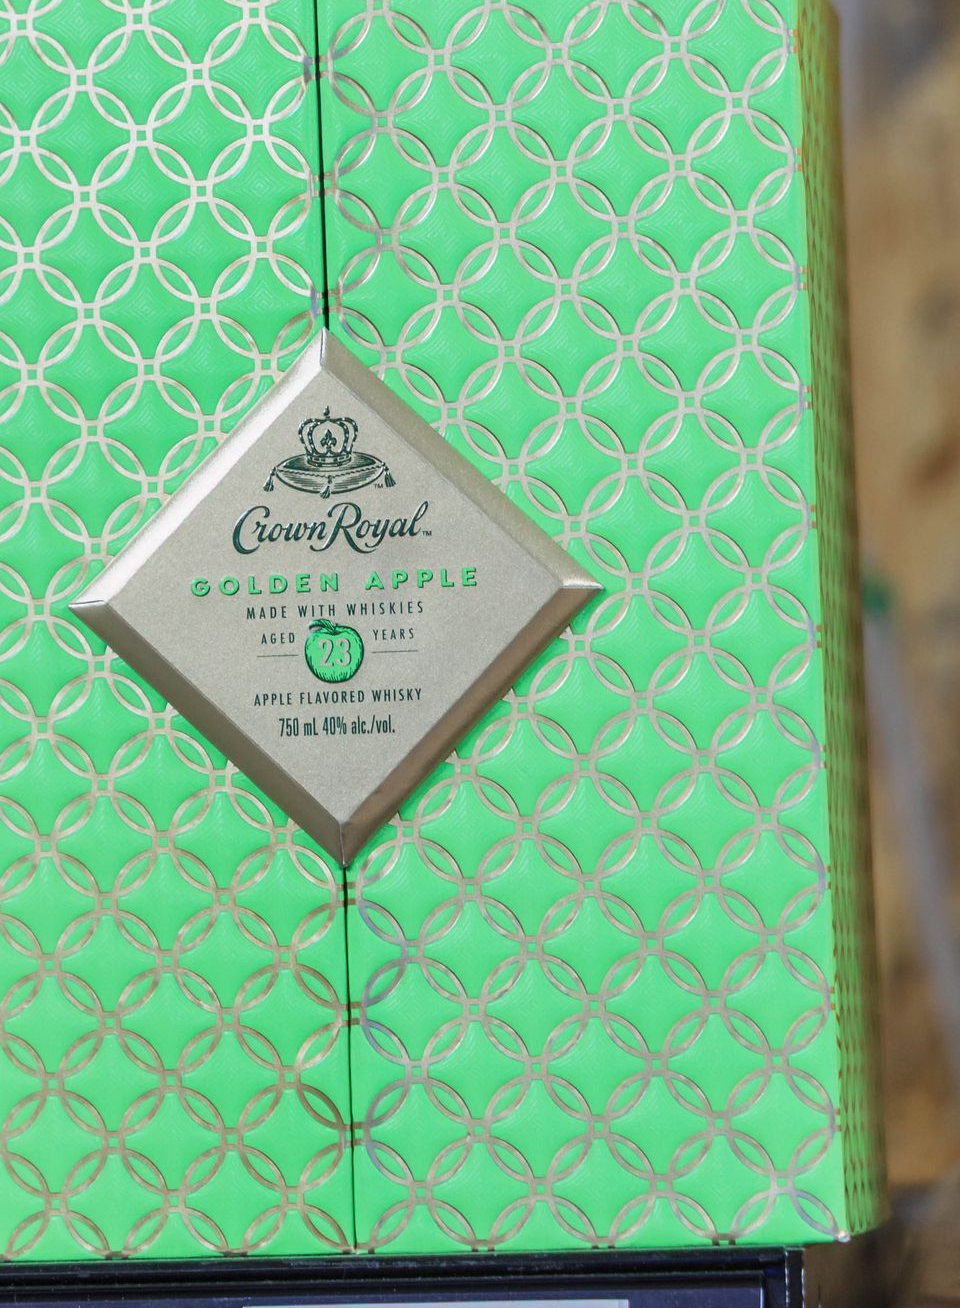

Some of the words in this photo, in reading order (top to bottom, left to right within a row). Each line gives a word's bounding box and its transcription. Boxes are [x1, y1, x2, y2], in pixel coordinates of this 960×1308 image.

[231, 505, 328, 555] Crown
[309, 500, 430, 554] Royal
[190, 572, 339, 597] GOLDEN
[364, 566, 478, 591] APPLE
[246, 605, 288, 620] MADE
[297, 603, 336, 618] WITH
[346, 600, 424, 617] WHISKIES
[260, 632, 296, 645] AGED
[318, 637, 351, 667] 23
[372, 627, 415, 641] YEARS
[253, 692, 293, 707] APPLE
[299, 690, 365, 705] FLAVORED
[371, 687, 422, 703] WHISKY
[278, 717, 299, 738] 750
[303, 717, 319, 737] mL
[322, 716, 348, 736] 40%
[351, 714, 396, 735] alc./vol.
